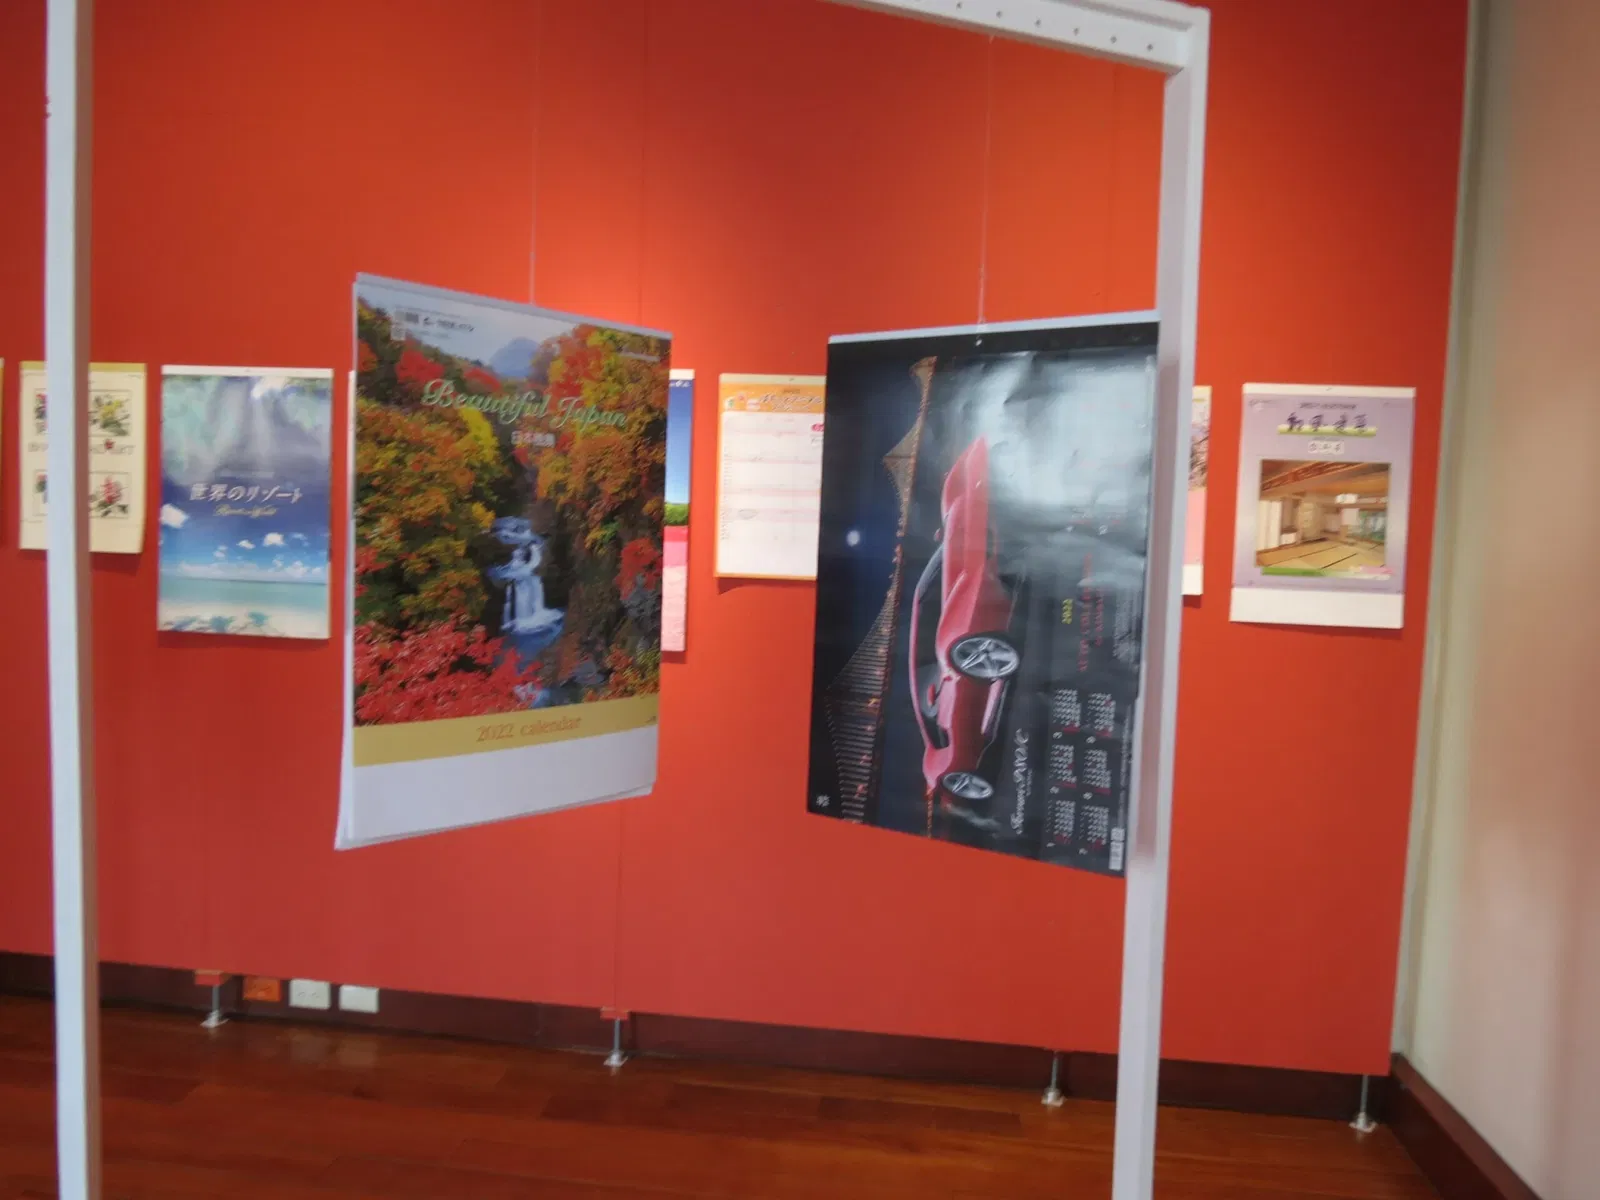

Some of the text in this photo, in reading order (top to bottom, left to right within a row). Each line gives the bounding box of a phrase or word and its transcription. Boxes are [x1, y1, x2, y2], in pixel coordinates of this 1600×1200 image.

[420, 378, 627, 433] Beautiful Japan
[190, 483, 304, 505] 世界のリゾート
[475, 706, 583, 743] 2022 calendar
